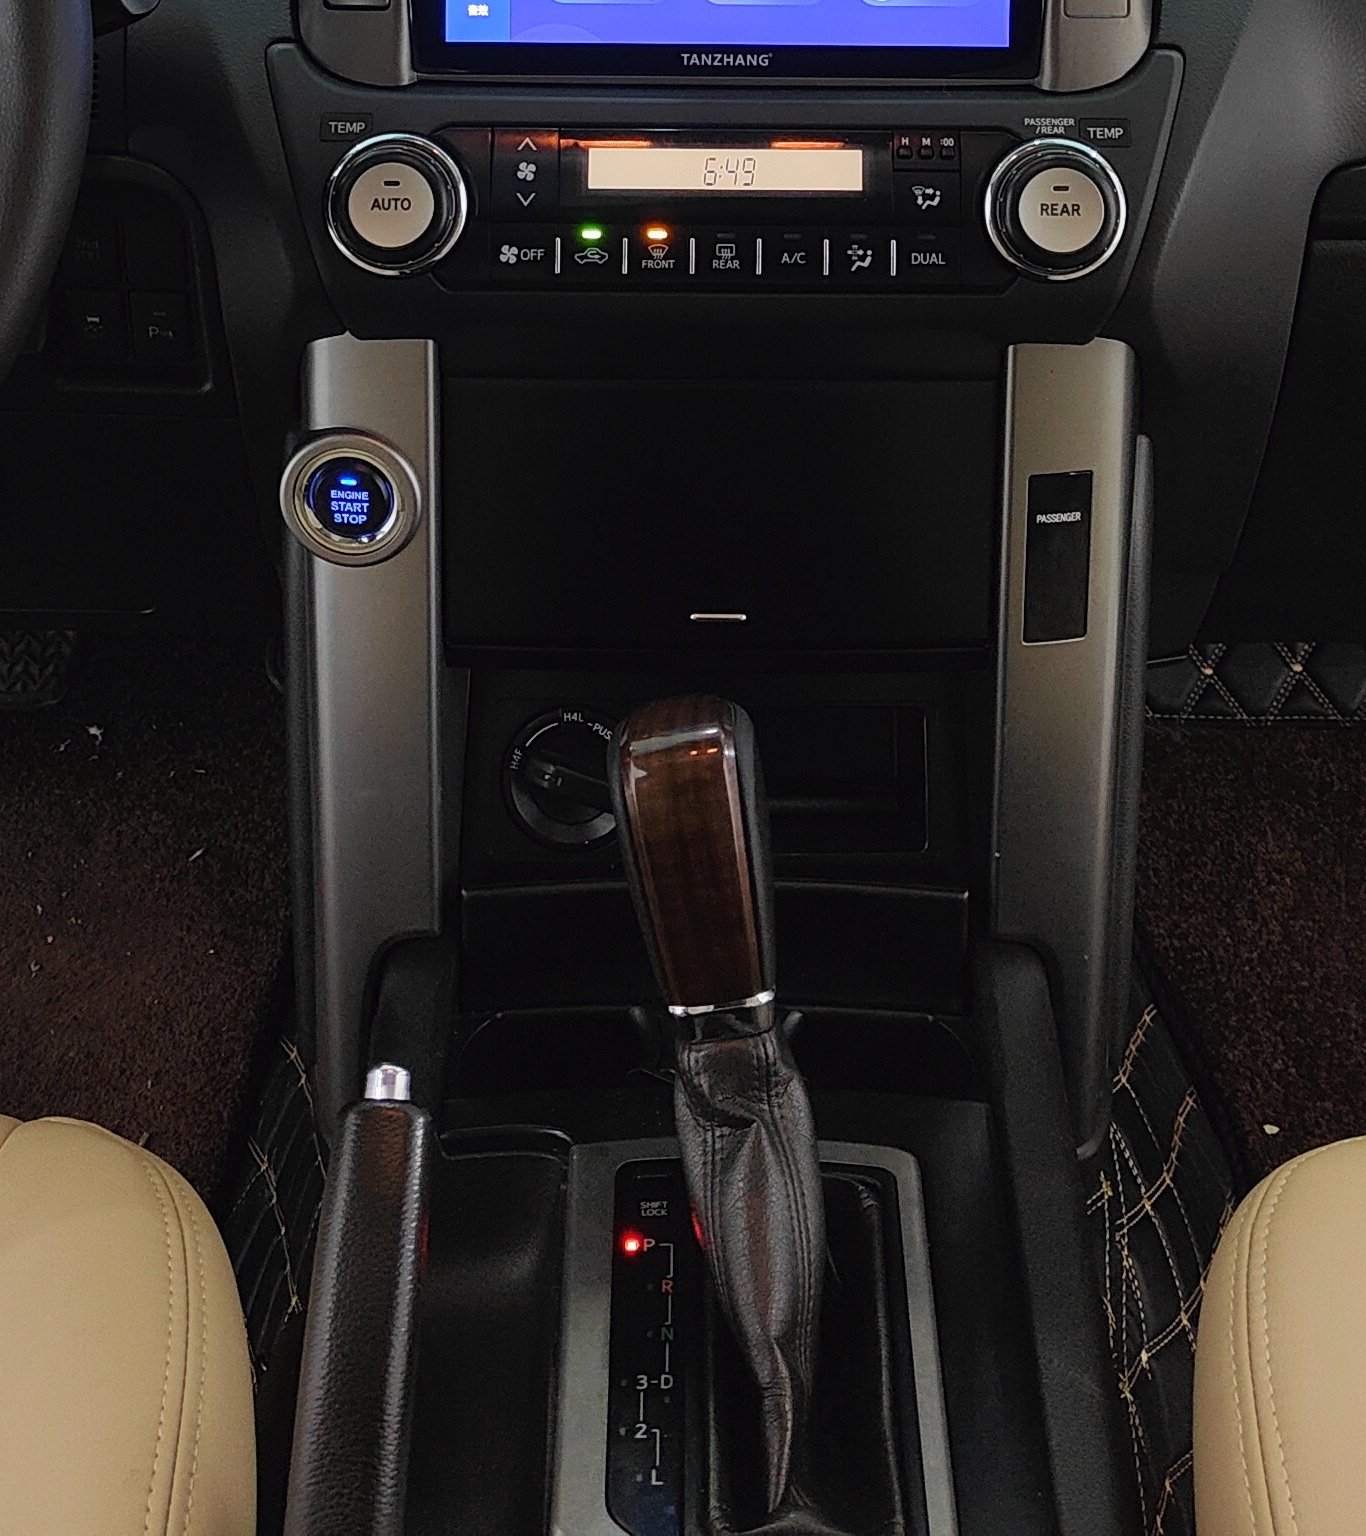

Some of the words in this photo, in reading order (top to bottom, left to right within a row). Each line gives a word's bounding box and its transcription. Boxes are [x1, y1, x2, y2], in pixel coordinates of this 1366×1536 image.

[328, 121, 366, 134] TEMP
[1024, 118, 1075, 127] PASSENGER
[1036, 126, 1065, 135] /REAR
[1087, 127, 1124, 139] TEMP
[901, 137, 910, 146] H
[922, 137, 931, 146] M
[703, 157, 756, 186] 6:49
[370, 197, 412, 211] AUTO
[1040, 203, 1081, 217] REAR
[520, 249, 545, 261] OFF
[781, 252, 807, 265] A/C
[911, 252, 946, 265] DUAL
[641, 259, 675, 269] FRONT
[712, 259, 740, 270] REAR
[330, 489, 369, 501] ENGINE
[330, 501, 369, 513] START
[333, 513, 367, 524] STOP
[1036, 511, 1081, 524] PASSENGER
[563, 712, 584, 723] H4L
[592, 722, 614, 741] PUS
[509, 748, 524, 770] H4F
[640, 1200, 669, 1209] SHIFT
[641, 1208, 668, 1217] LOCK
[643, 1239, 655, 1251] P
[662, 1280, 673, 1293] R
[661, 1328, 674, 1341] N
[635, 1424, 648, 1439] 2
[651, 1469, 664, 1485] L
